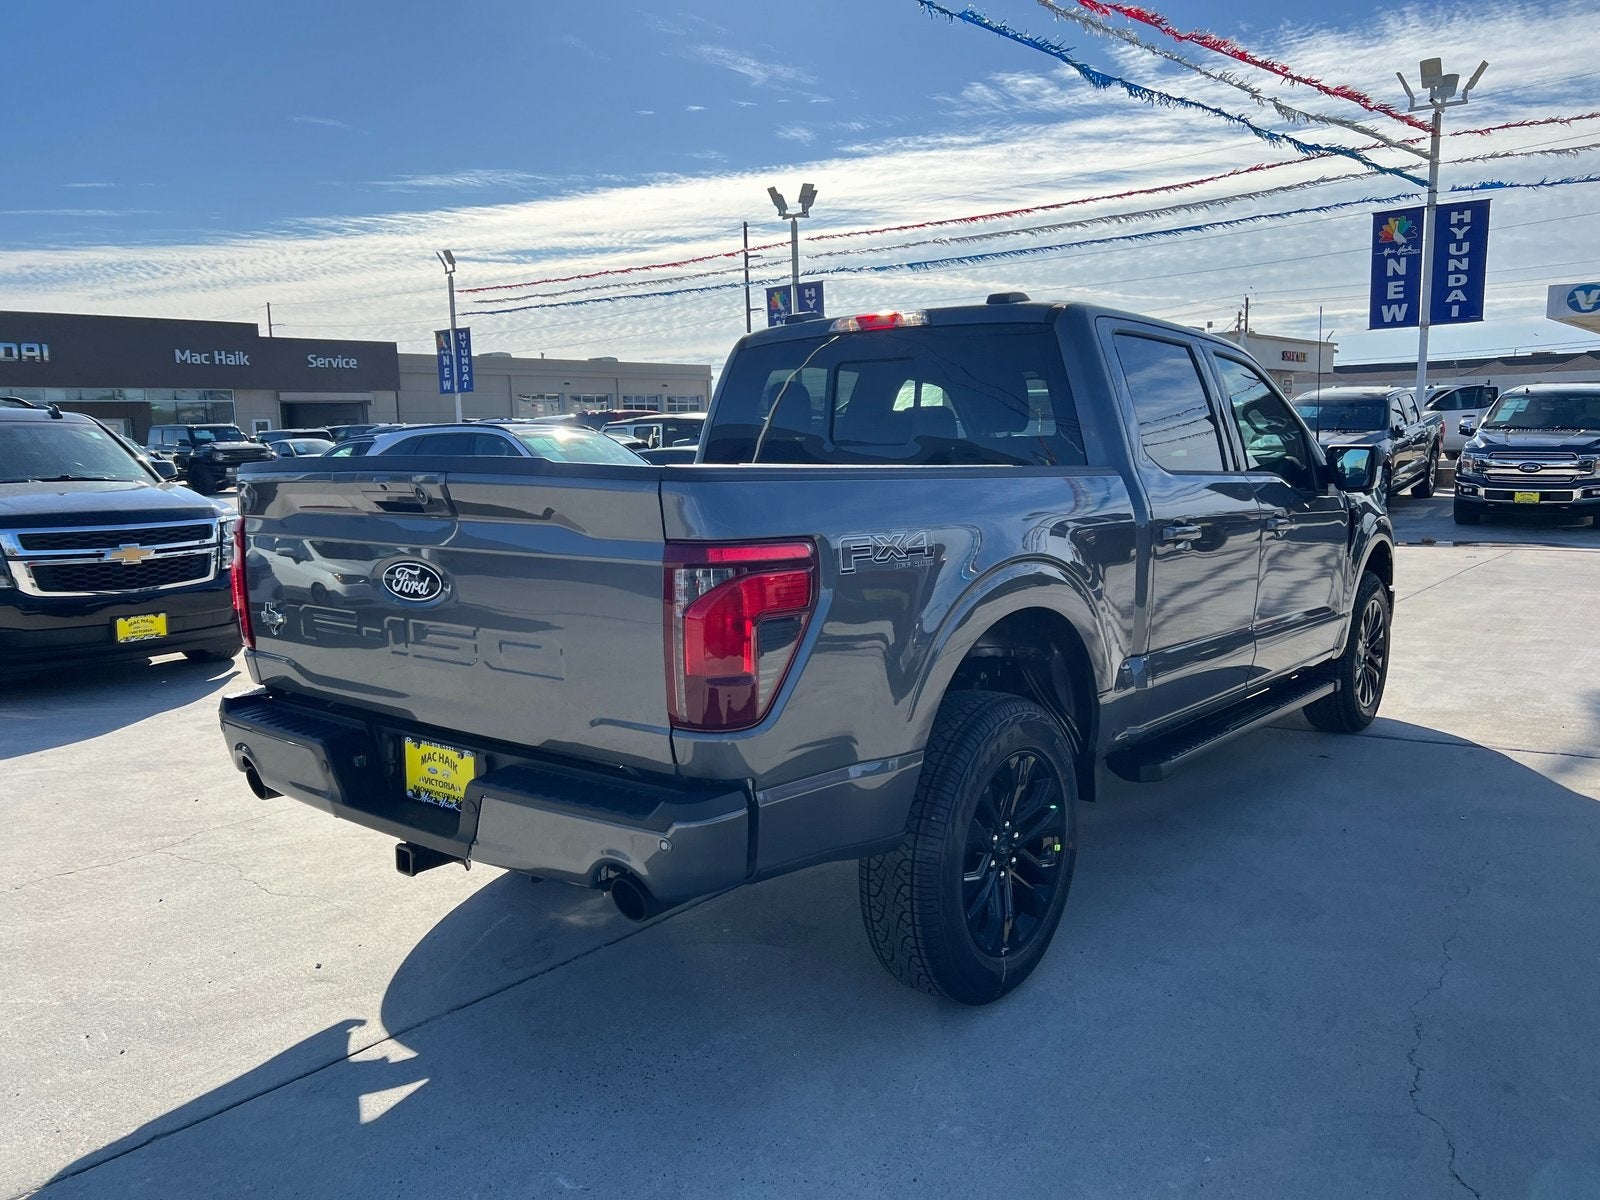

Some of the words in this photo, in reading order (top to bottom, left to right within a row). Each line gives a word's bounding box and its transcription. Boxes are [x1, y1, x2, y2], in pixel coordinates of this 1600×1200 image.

[1445, 209, 1471, 318] HYUNDAI
[1381, 257, 1408, 323] NEW
[174, 348, 210, 364] Mac
[213, 350, 250, 366] Haik
[307, 354, 358, 369] Service
[443, 355, 452, 390] NEW
[458, 332, 469, 389] HYUNDAI
[839, 529, 936, 575] FX4
[392, 567, 430, 595] Ford
[420, 751, 437, 765] MAC
[438, 752, 458, 774] HAIK
[424, 776, 456, 791] VICTORIA
